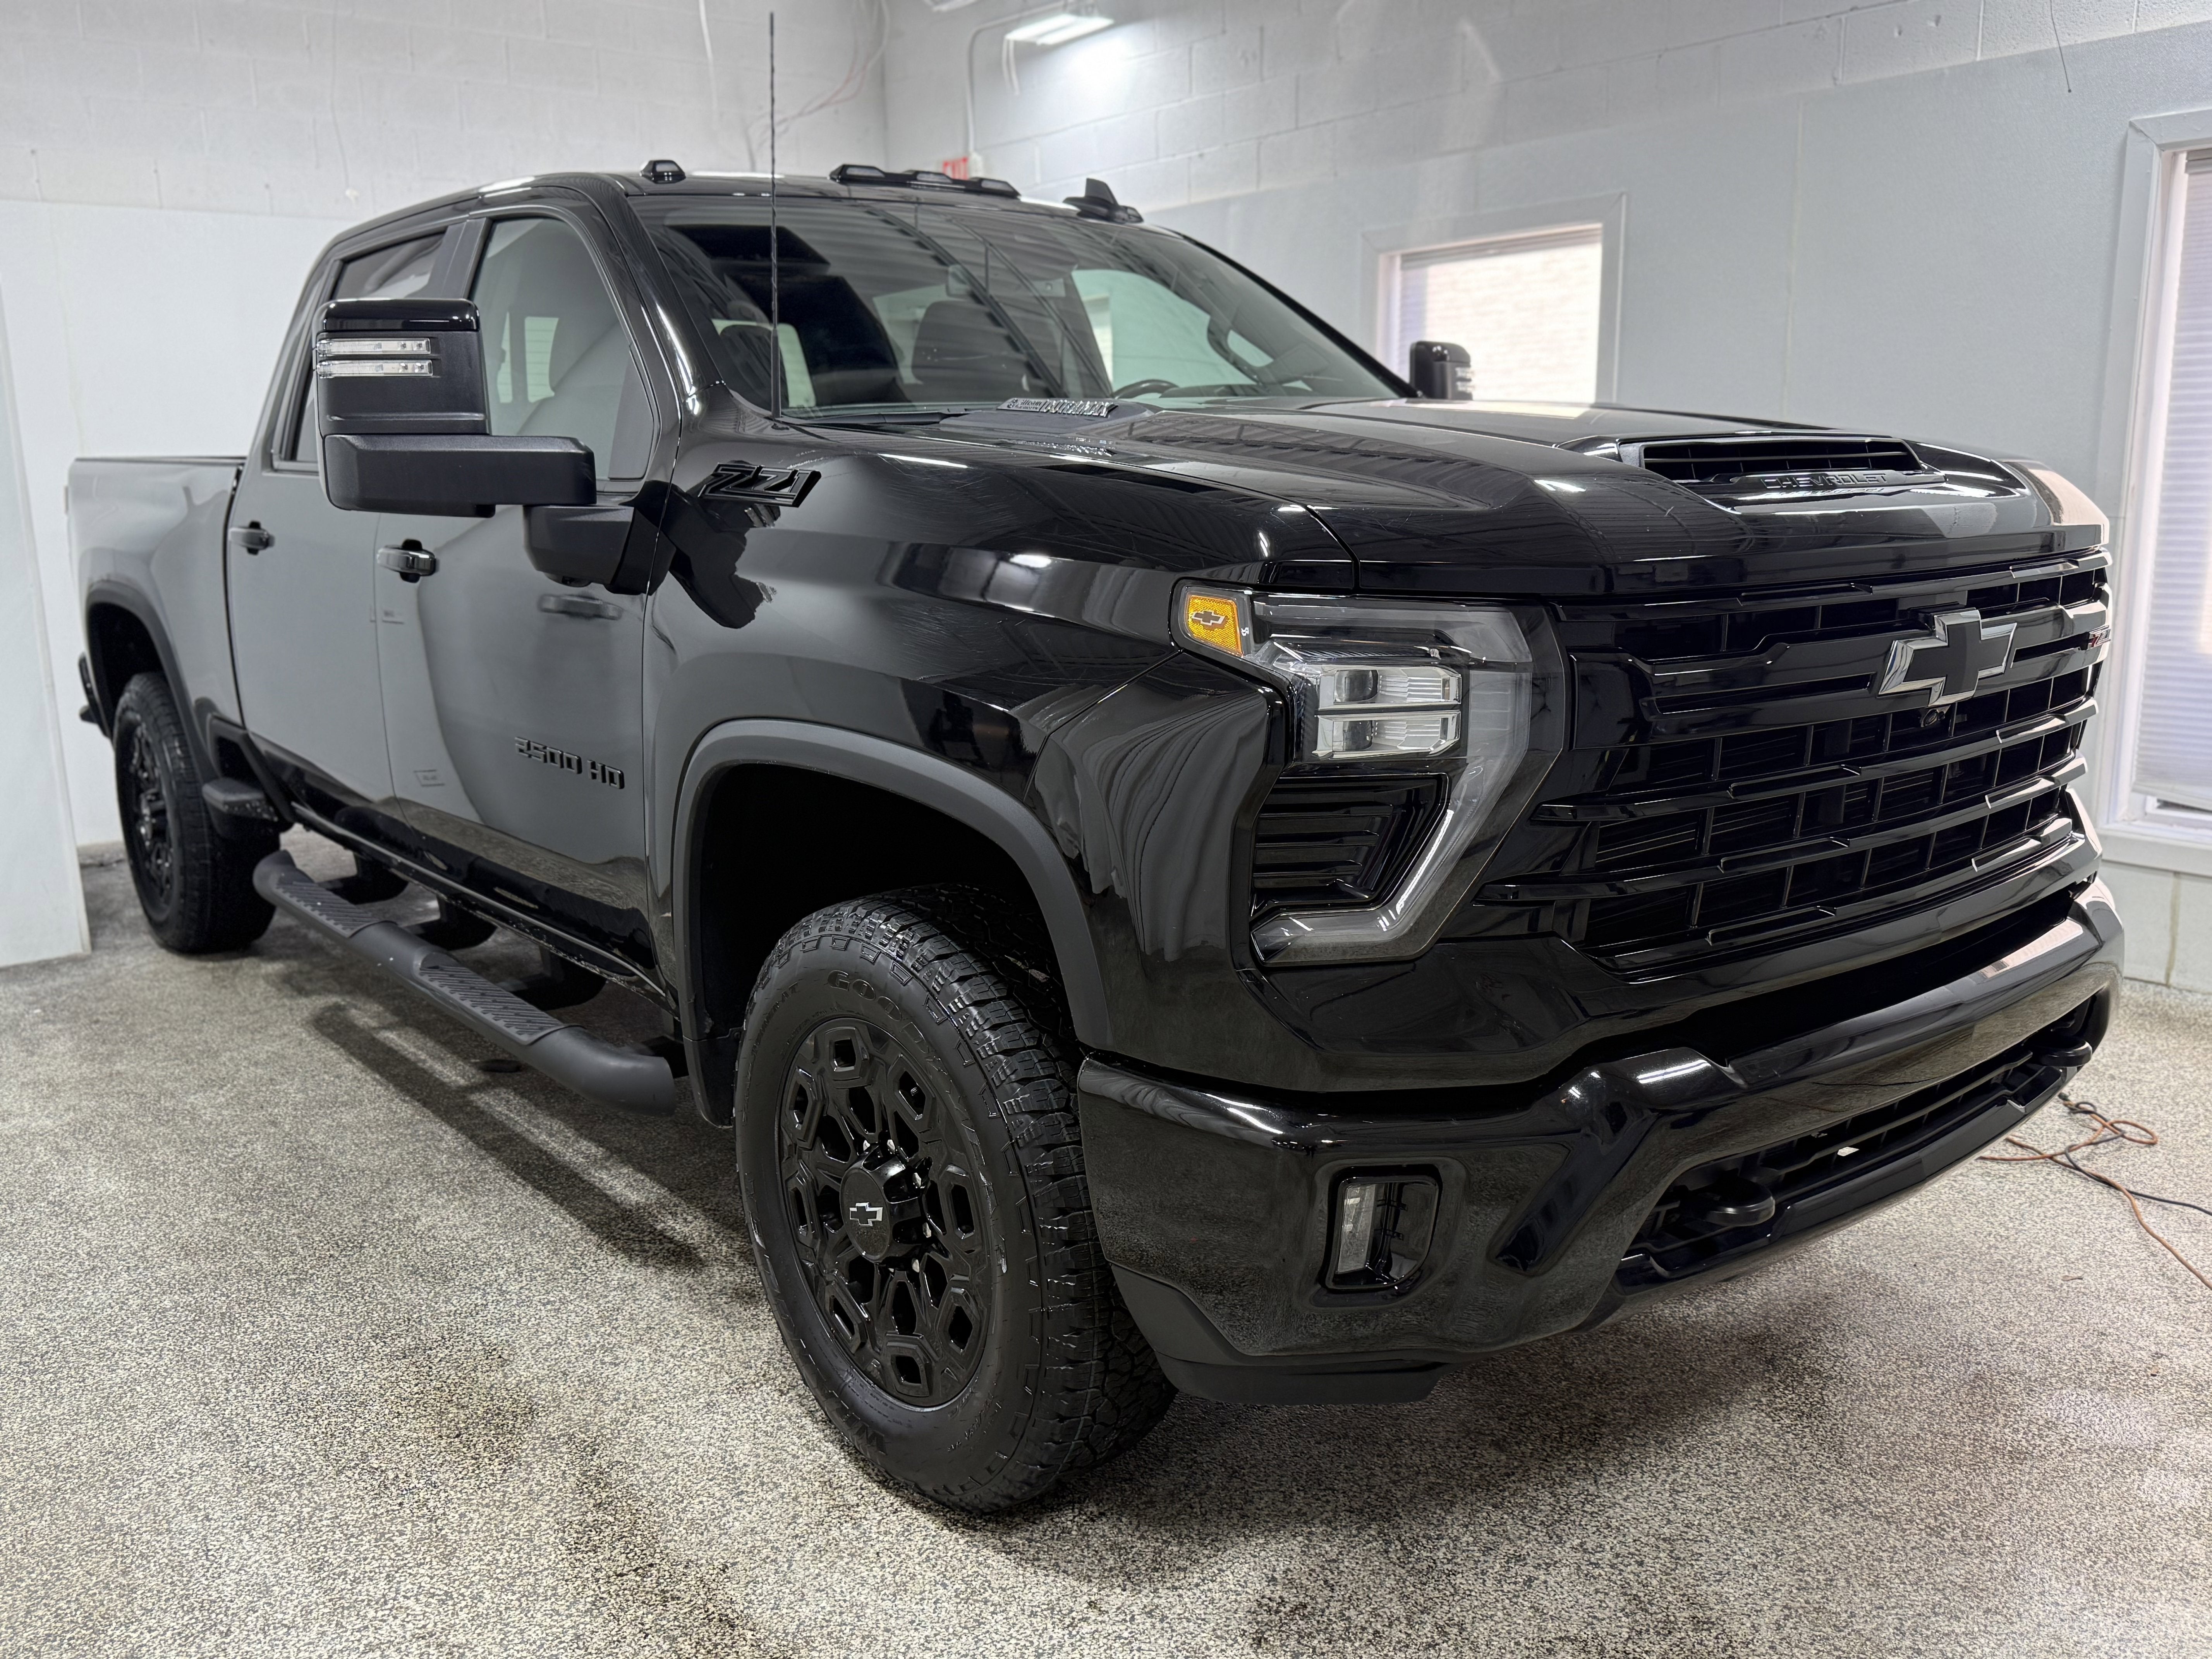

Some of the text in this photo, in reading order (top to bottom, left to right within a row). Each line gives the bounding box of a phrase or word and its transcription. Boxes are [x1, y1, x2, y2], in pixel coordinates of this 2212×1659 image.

[697, 463, 819, 507] Z71
[1761, 473, 1886, 489] CHEVROLET
[515, 737, 625, 789] 2500 HD
